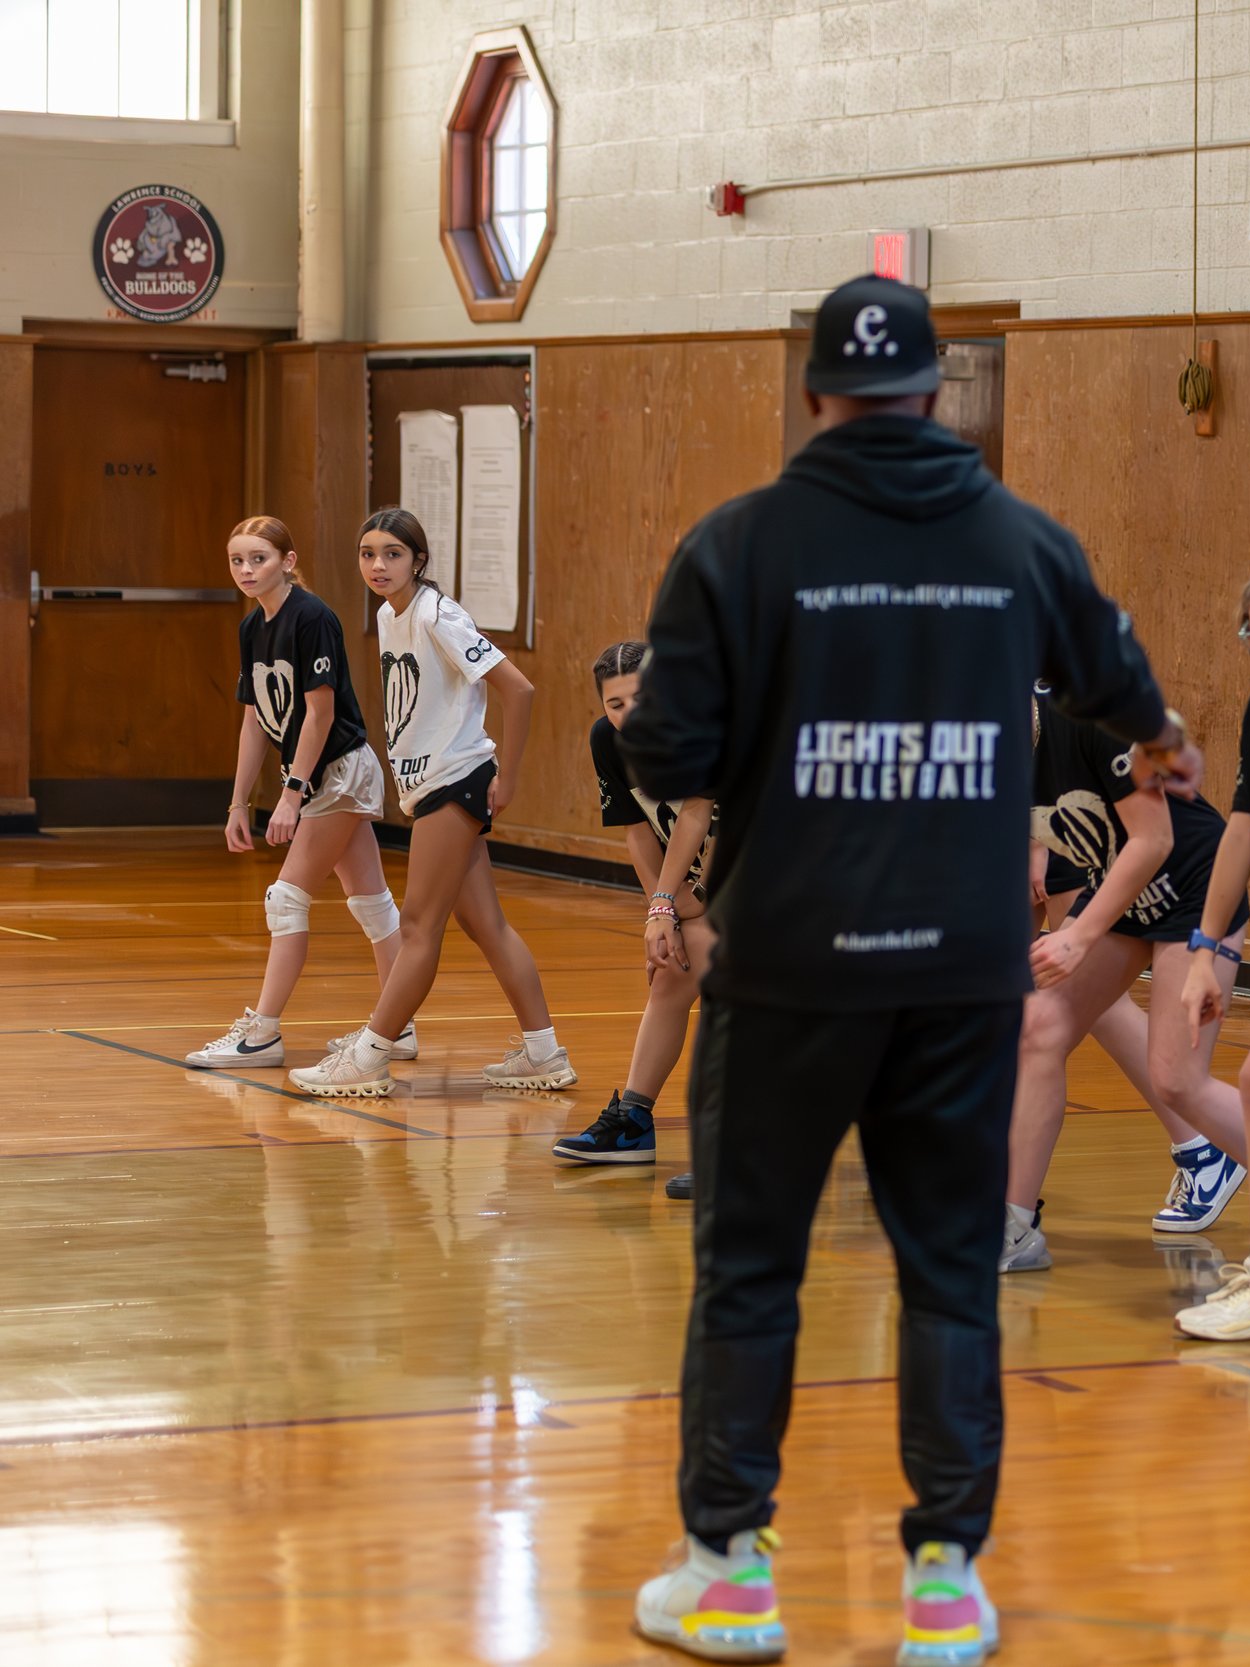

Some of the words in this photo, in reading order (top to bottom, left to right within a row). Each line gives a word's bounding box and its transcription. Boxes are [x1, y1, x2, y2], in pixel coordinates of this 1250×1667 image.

[112, 187, 160, 213] LAWRENCE
[164, 187, 201, 212] SCHOOL
[125, 280, 196, 295] BULLDOGS
[104, 462, 157, 477] BOYS
[796, 721, 924, 764] LIGHTS
[929, 721, 1001, 764] OUT
[400, 754, 431, 775] OUT
[795, 761, 995, 800] VOLLEYBALL
[1197, 1149, 1211, 1162] NIKE
